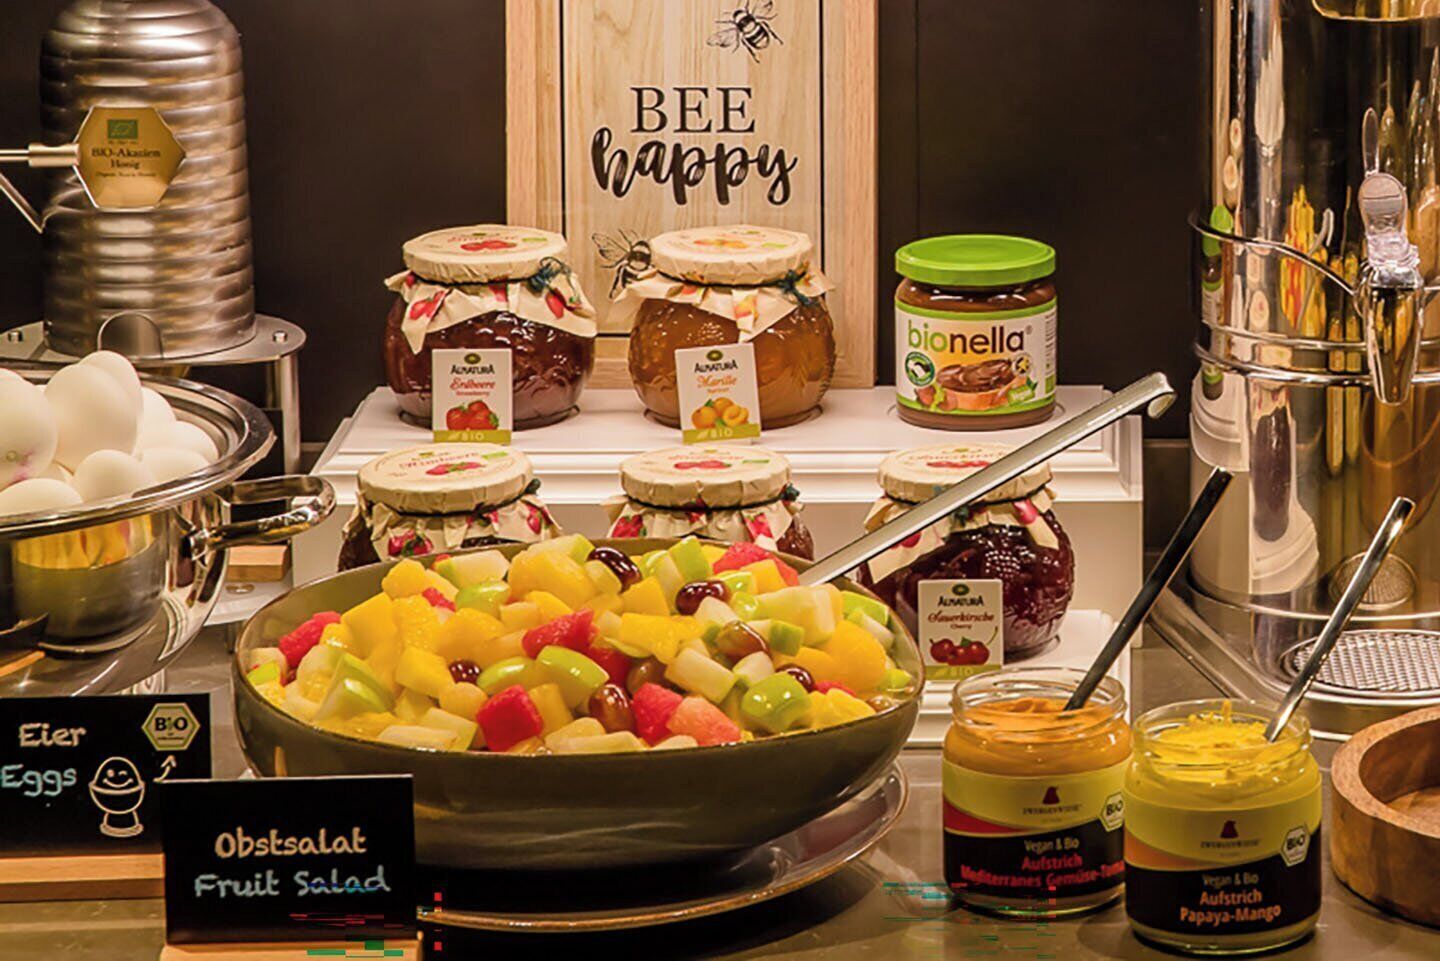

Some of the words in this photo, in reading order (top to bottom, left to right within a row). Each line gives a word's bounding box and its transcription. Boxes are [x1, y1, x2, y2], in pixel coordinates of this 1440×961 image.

[630, 86, 756, 134] BEE
[590, 127, 798, 205] happy
[908, 319, 1025, 355] bionella
[450, 377, 496, 391] Erdbeere
[461, 432, 485, 442] BIO
[928, 610, 995, 623] Sauerkirsche
[18, 723, 87, 748] Eier
[0, 764, 78, 797] Eggs
[214, 825, 367, 859] Obstsalat
[1024, 839, 1055, 855] Vegan
[1064, 837, 1080, 850] Bio
[1021, 853, 1083, 871] Aufstrich
[194, 869, 280, 898] Fruit
[293, 865, 392, 897] Salad
[1202, 873, 1232, 889] Vegan
[1243, 872, 1259, 885] Bio
[1200, 888, 1263, 906] Aufstrich
[1180, 904, 1282, 928] Papaya-Mango
